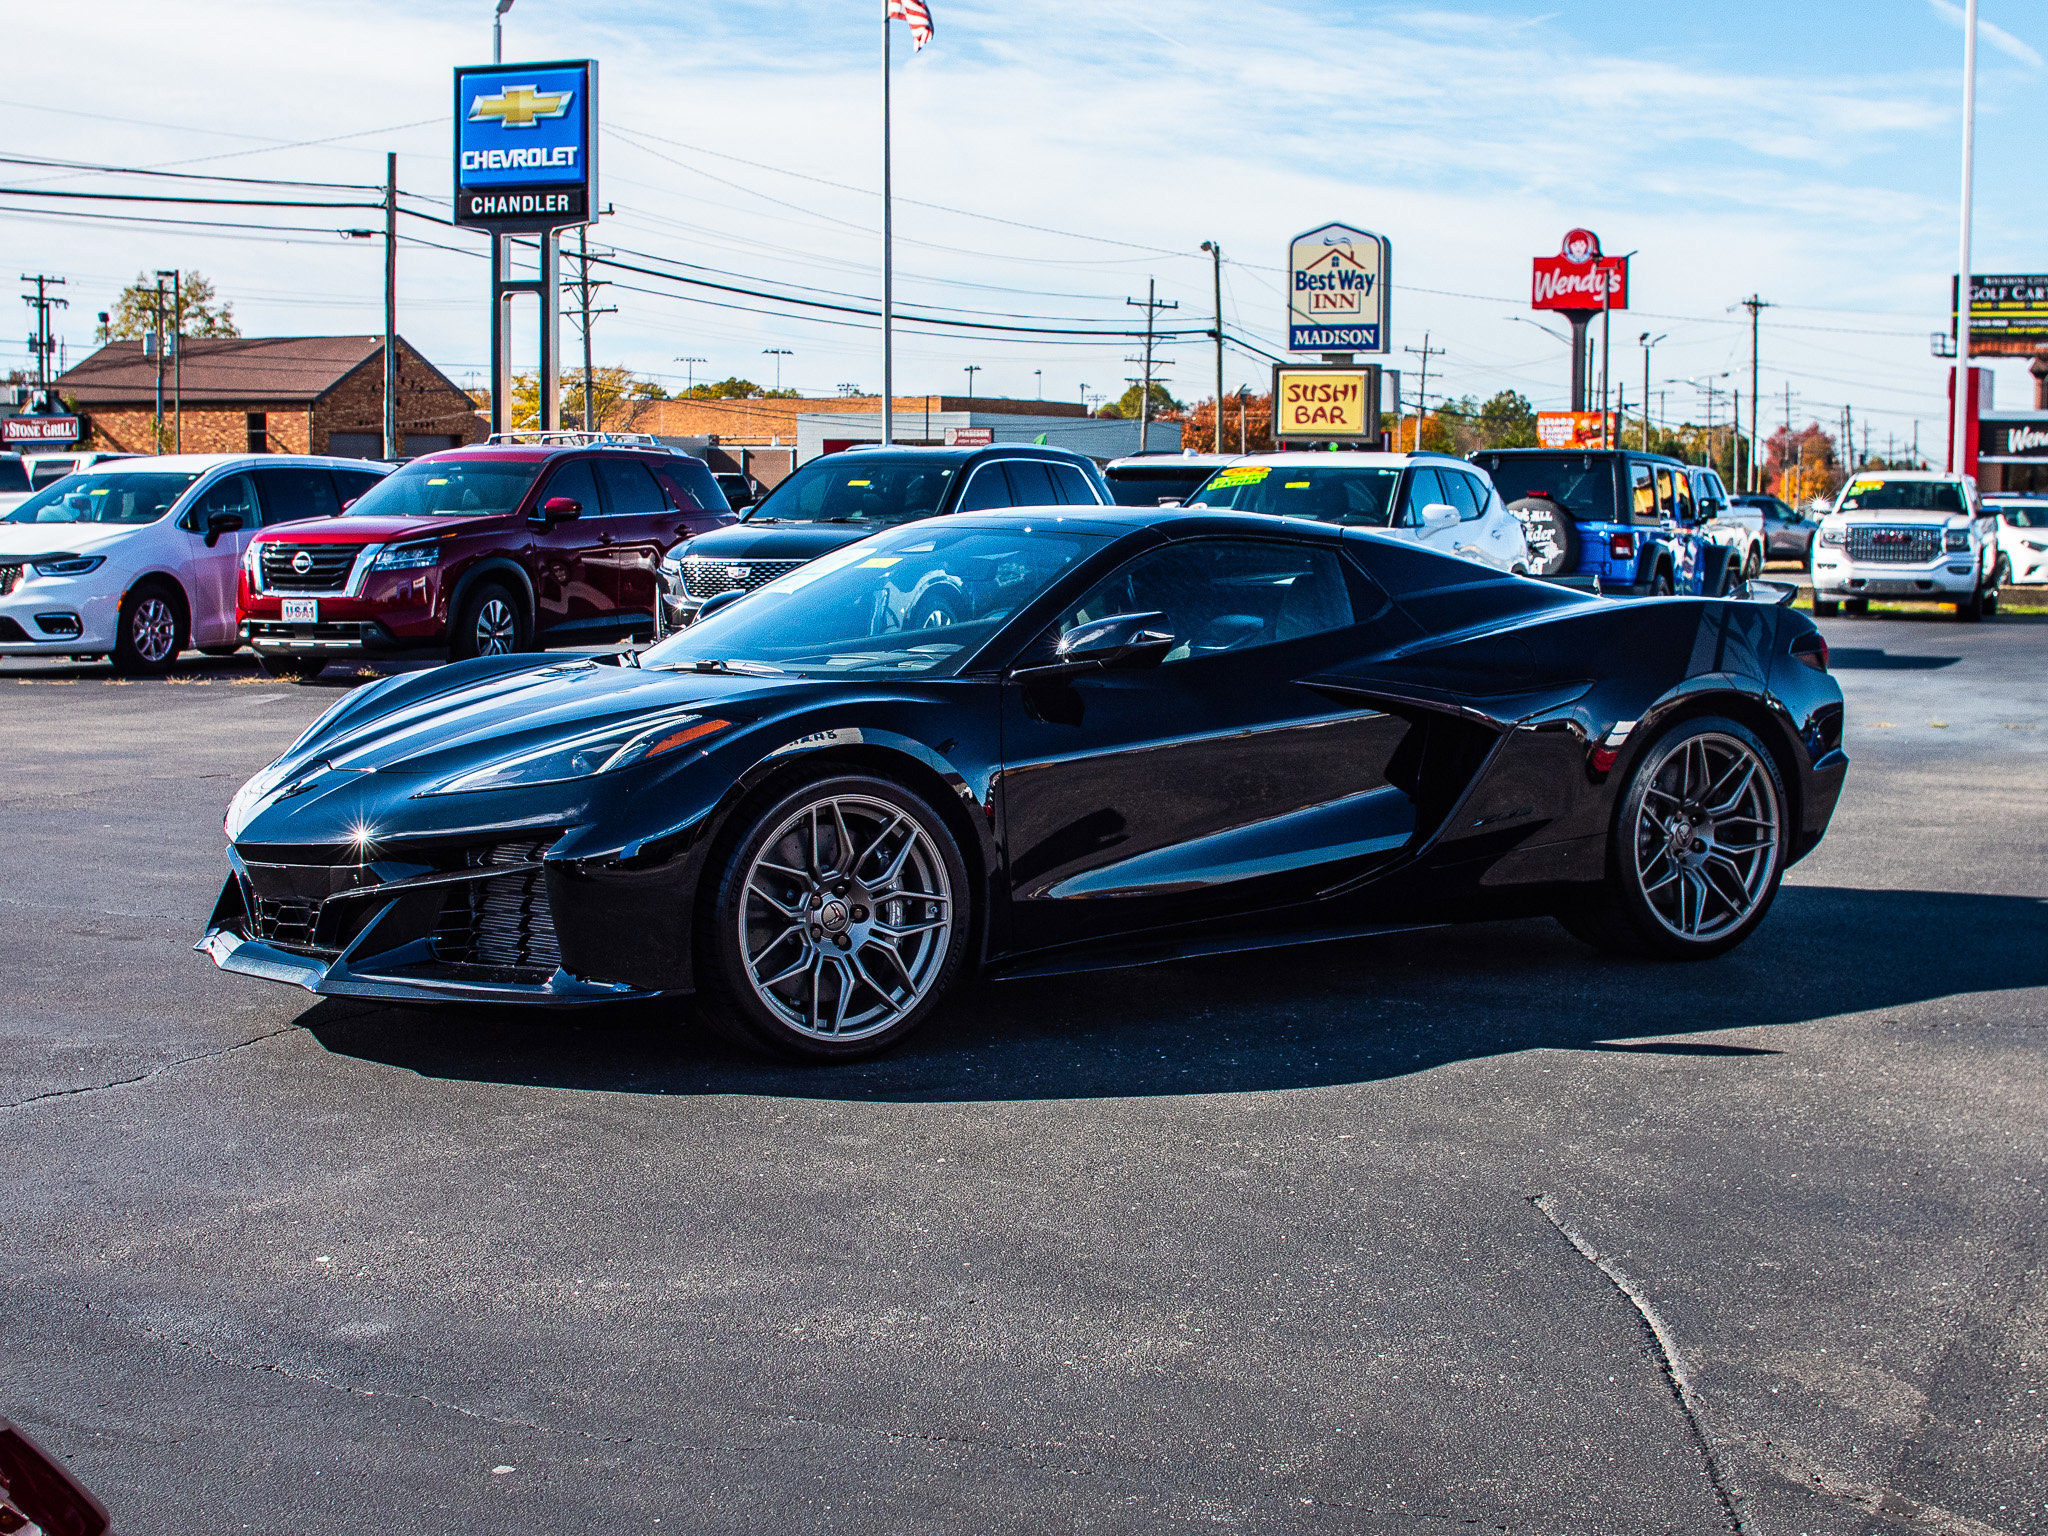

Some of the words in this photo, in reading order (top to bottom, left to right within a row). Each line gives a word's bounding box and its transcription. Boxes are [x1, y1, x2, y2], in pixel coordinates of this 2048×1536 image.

[462, 146, 578, 170] CHEVROLET
[471, 194, 569, 214] CHANDLER
[1295, 270, 1336, 291] Best
[1337, 269, 1376, 297] Way
[1534, 263, 1621, 302] Wendy's
[1314, 293, 1355, 309] INN
[1294, 329, 1375, 345] MADISON
[1287, 384, 1357, 402] SUSHI
[1295, 406, 1348, 424] BAR
[9, 421, 41, 437] STONE
[43, 422, 72, 437] GRILL
[2008, 426, 2048, 453] Wen
[1530, 510, 1552, 521] ALL
[286, 606, 315, 617] USA1
